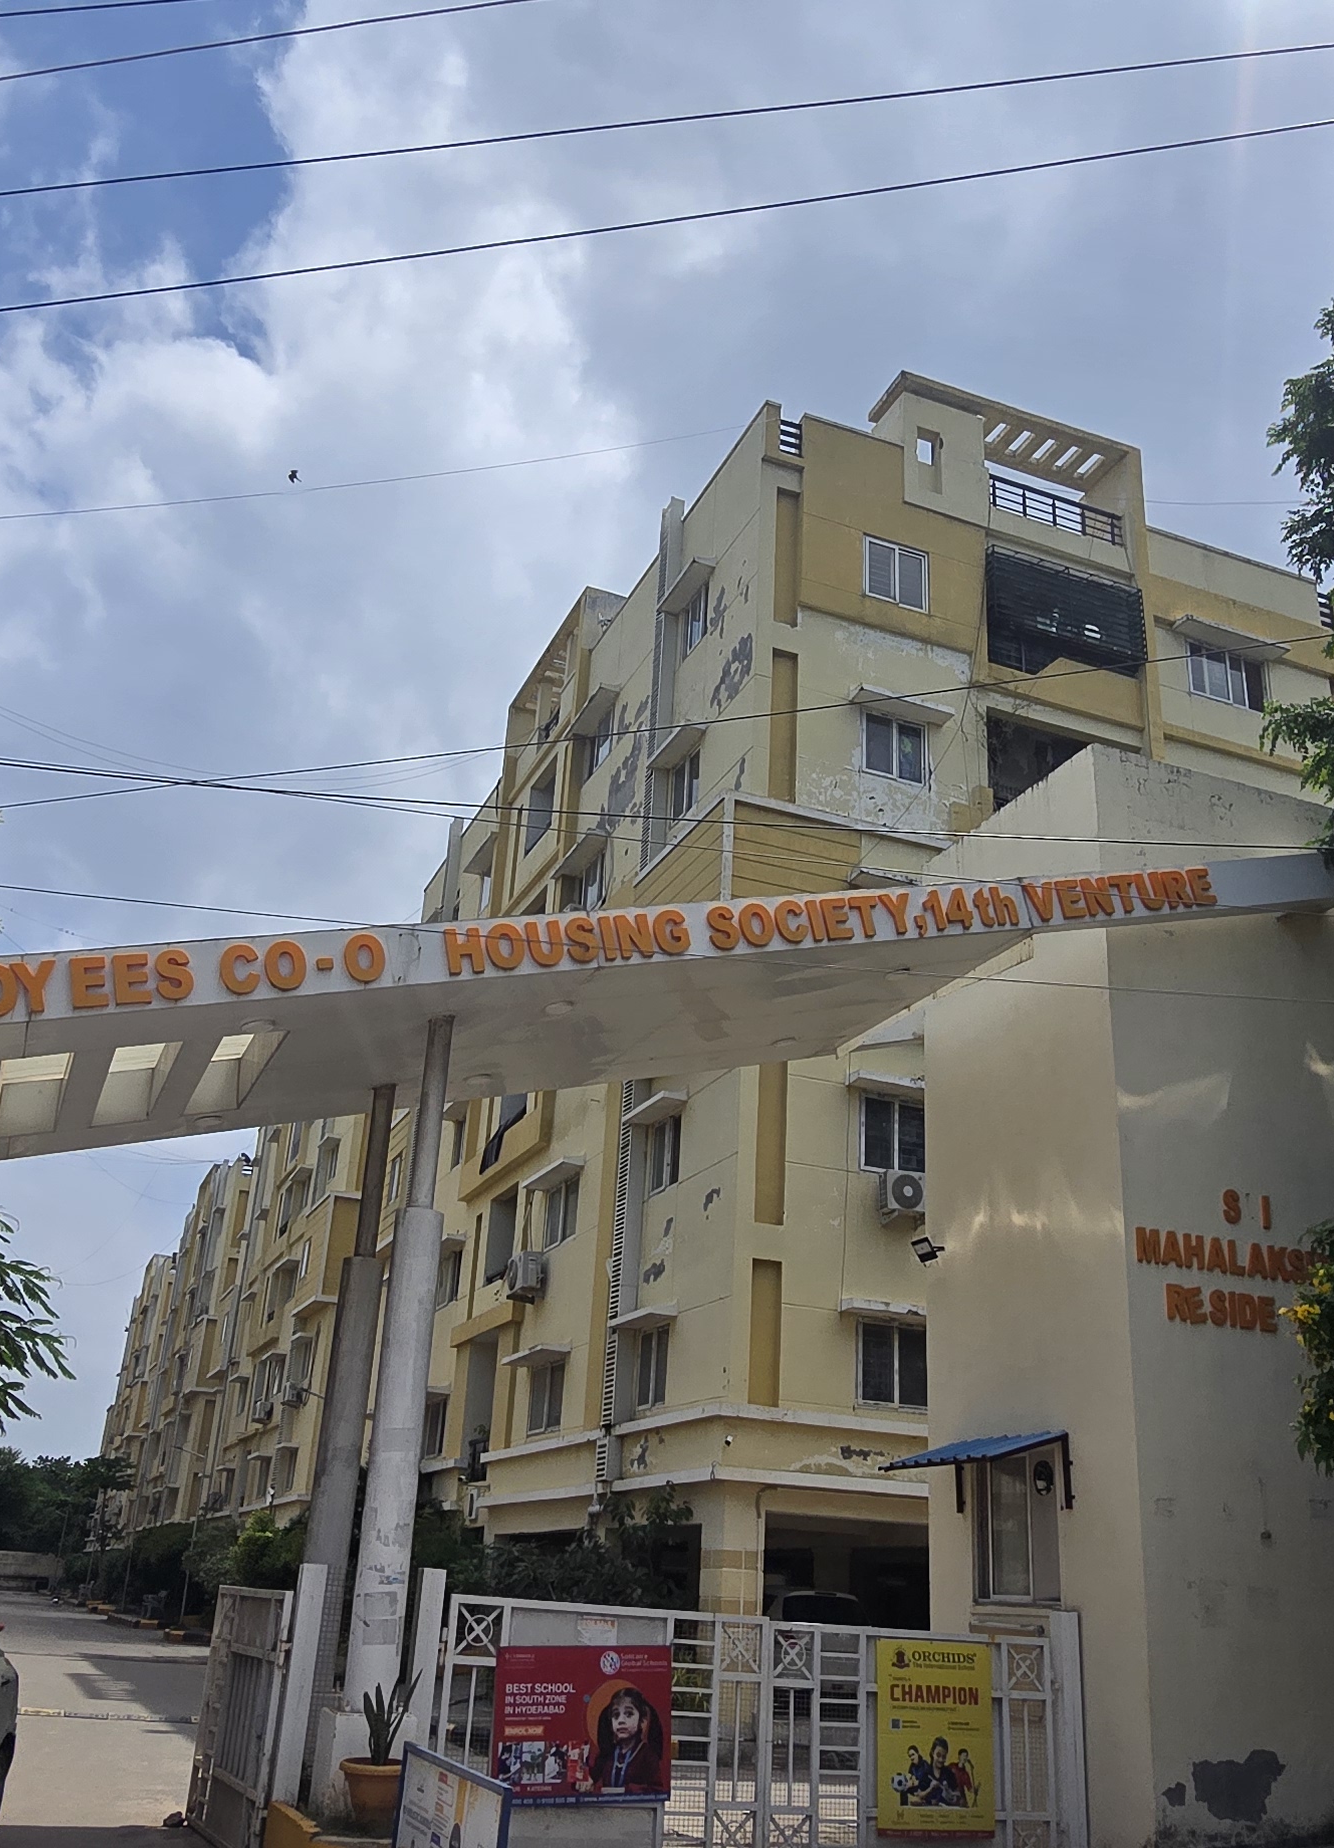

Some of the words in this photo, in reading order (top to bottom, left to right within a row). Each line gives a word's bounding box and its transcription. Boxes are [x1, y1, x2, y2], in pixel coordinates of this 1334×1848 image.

[442, 906, 690, 975] HOUSING
[1021, 867, 1218, 923] VENTURE
[911, 1650, 975, 1664] ORCHIDS
[505, 1683, 532, 1693] BEST
[534, 1683, 576, 1693] SCHOOL
[515, 1695, 544, 1704] SOUTH
[545, 1695, 567, 1703] ZONE
[889, 1684, 979, 1706] CHAMPION
[504, 1706, 514, 1714] IN
[515, 1705, 566, 1714] HYDERABAD
